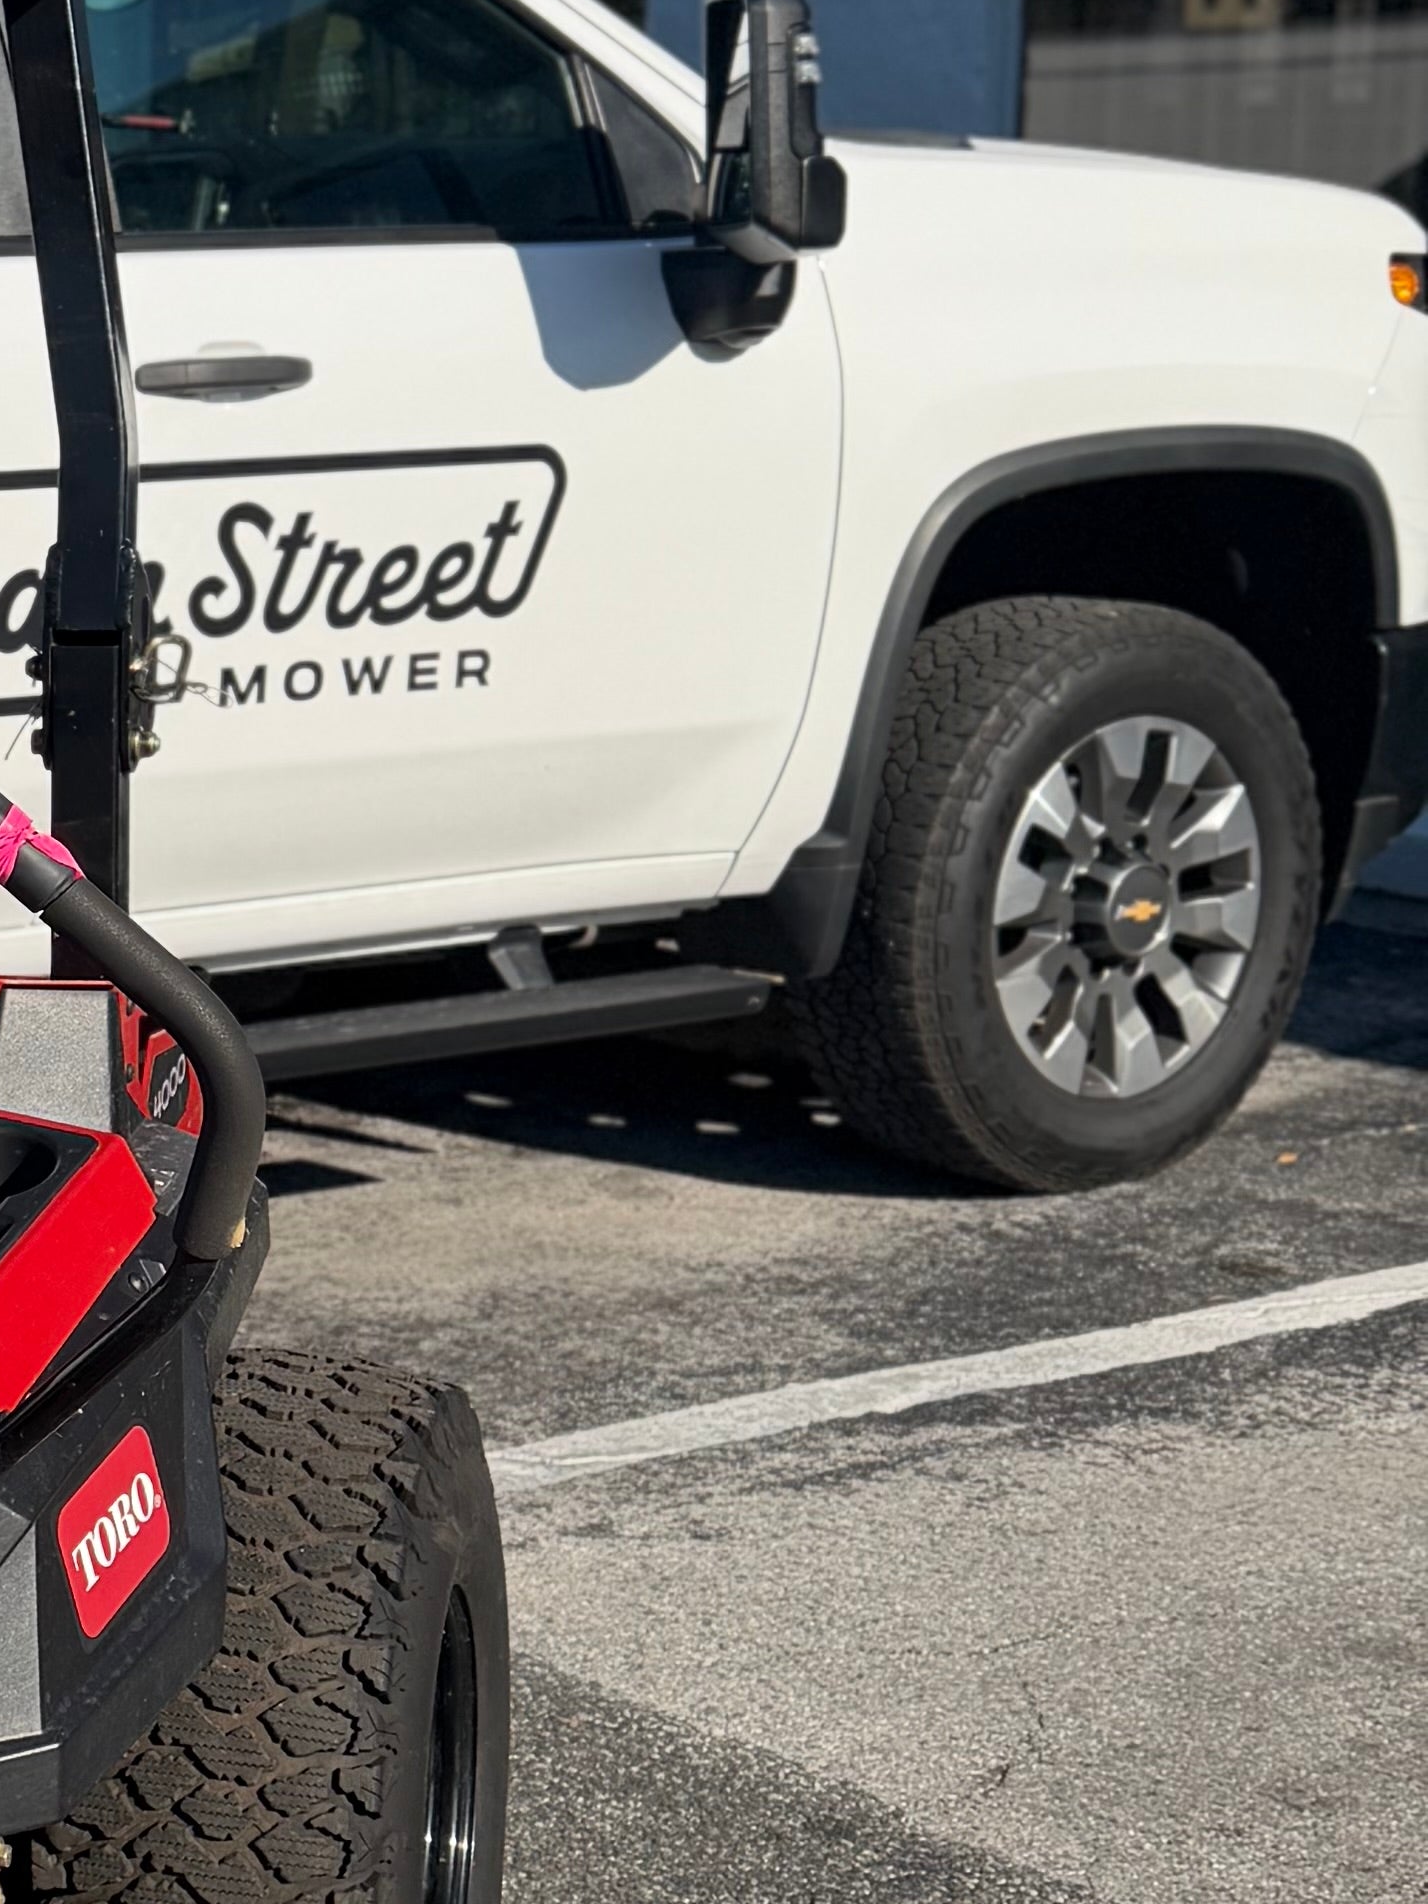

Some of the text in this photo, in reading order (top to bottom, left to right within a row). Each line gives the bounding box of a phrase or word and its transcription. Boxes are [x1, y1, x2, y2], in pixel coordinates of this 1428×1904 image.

[188, 500, 524, 638] Street
[219, 648, 493, 708] MOWER
[153, 1053, 187, 1119] 4000
[71, 1472, 155, 1593] TORO
